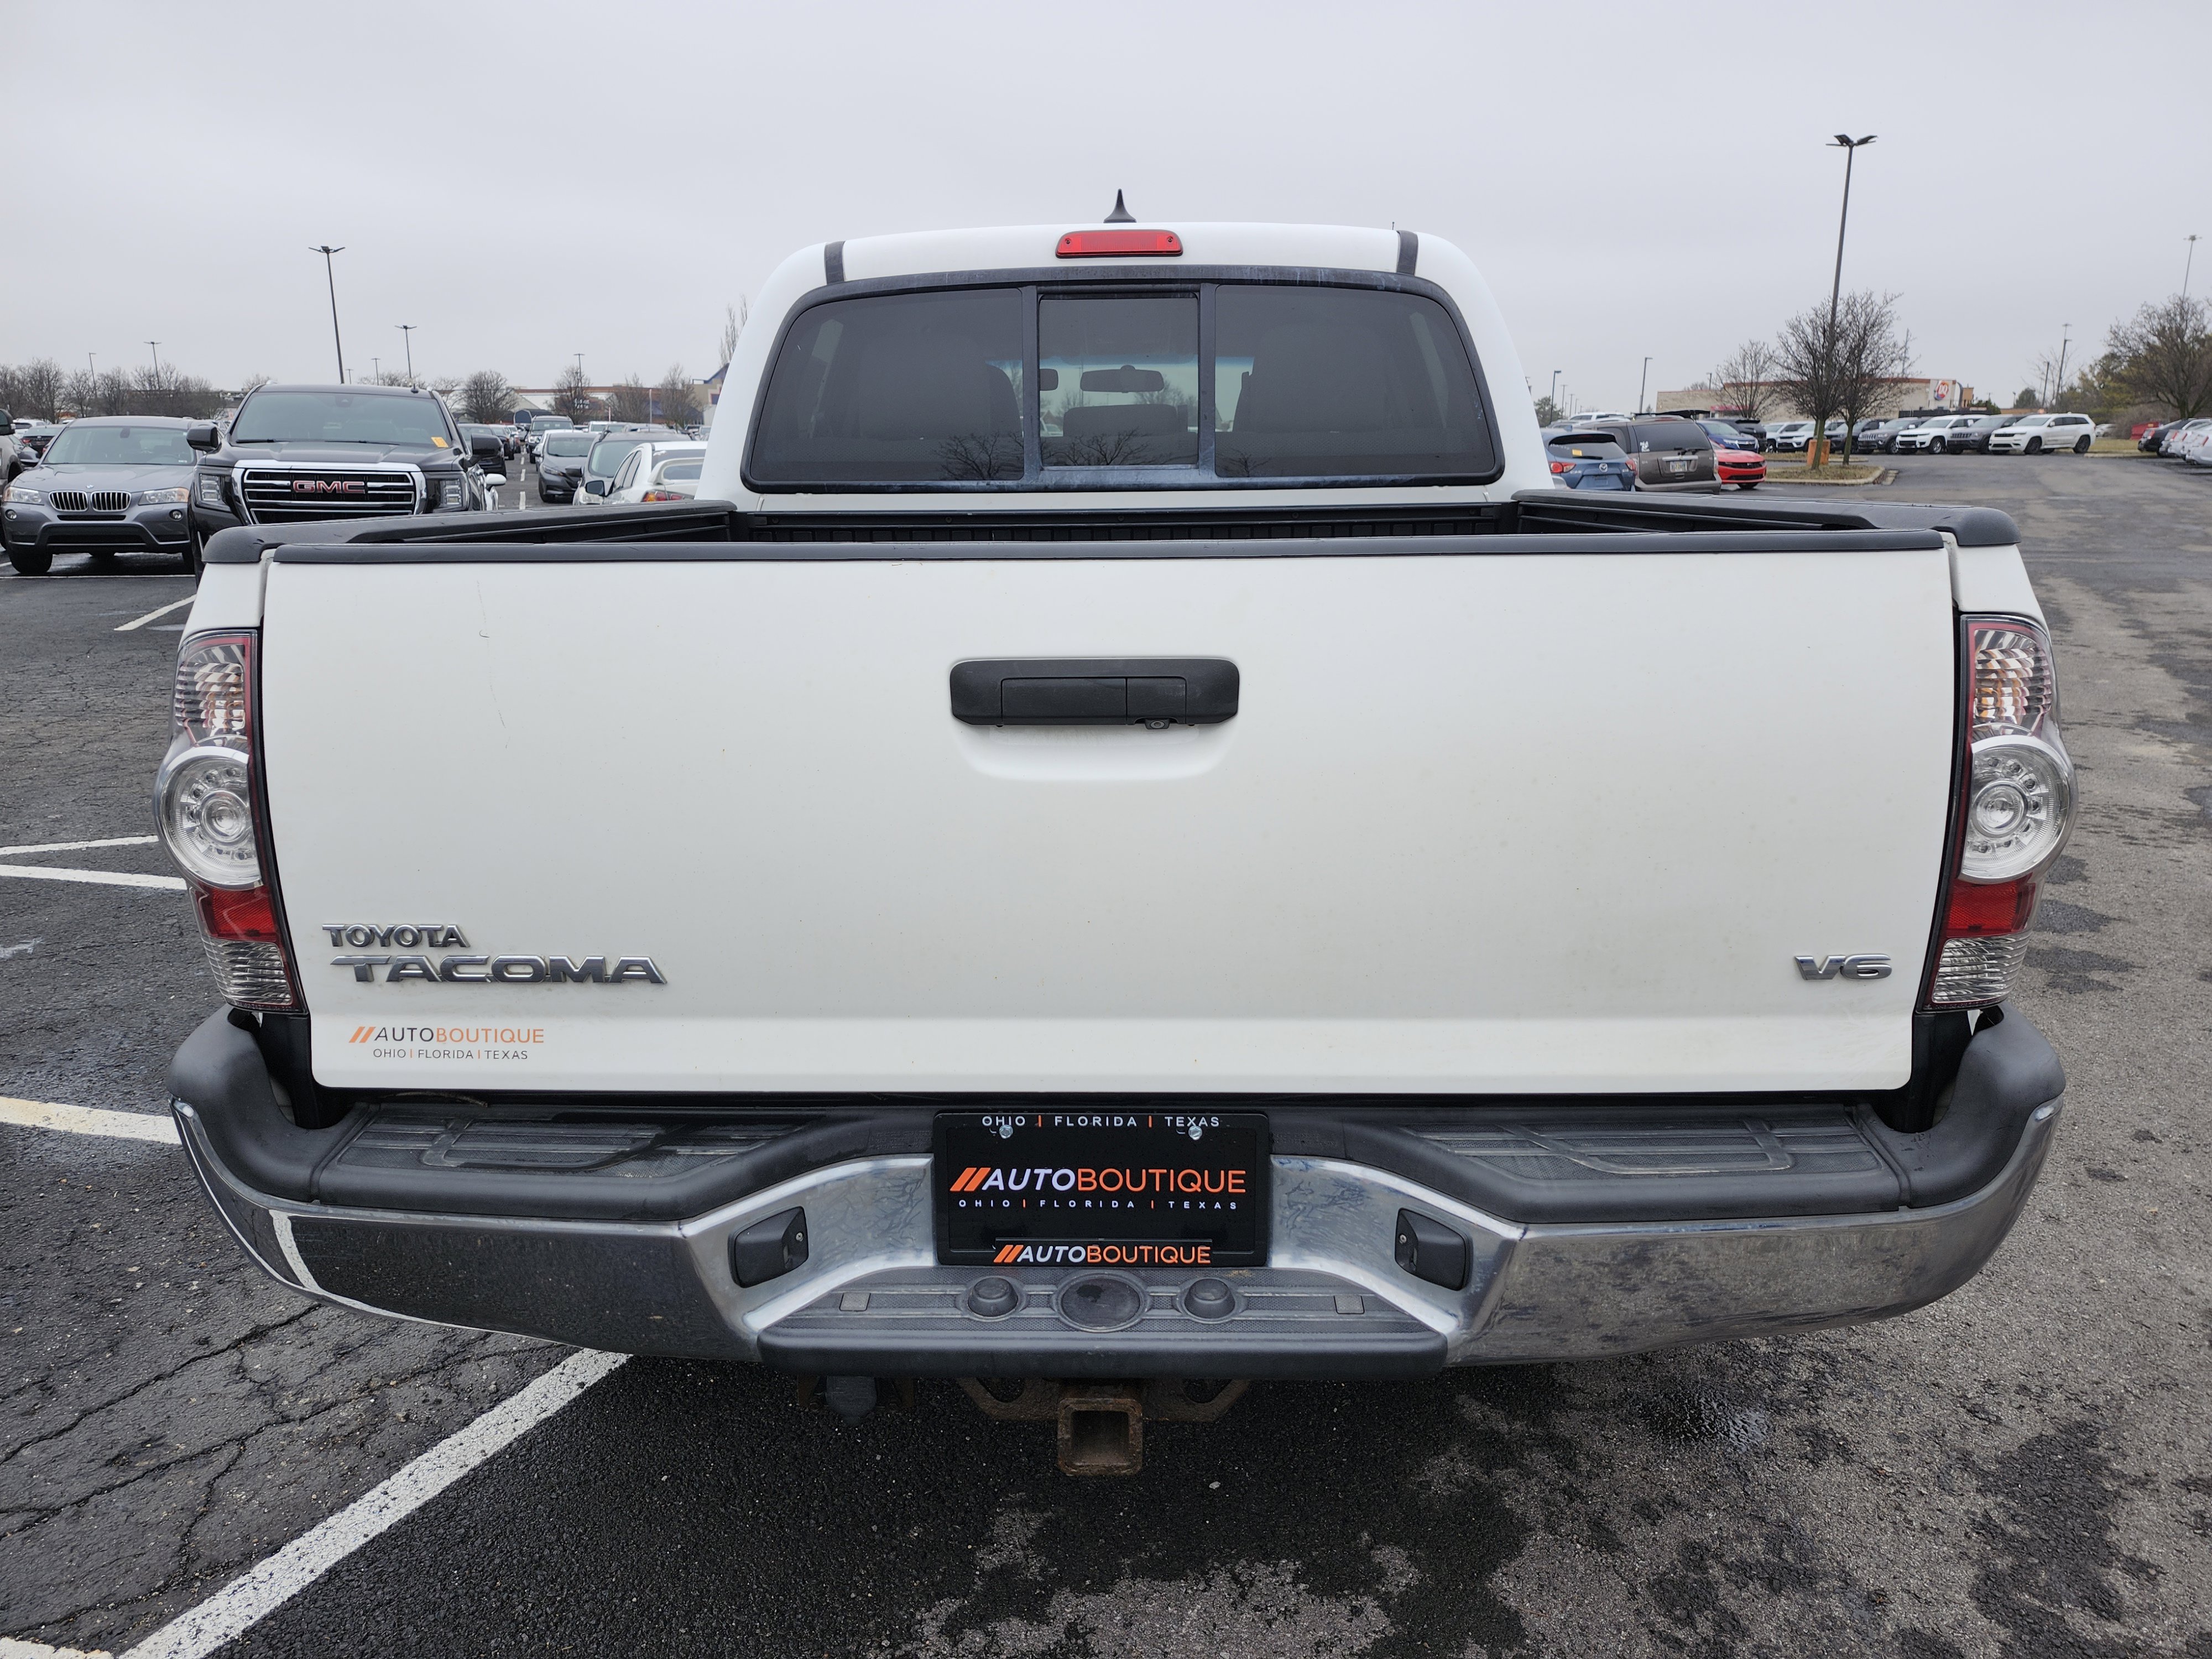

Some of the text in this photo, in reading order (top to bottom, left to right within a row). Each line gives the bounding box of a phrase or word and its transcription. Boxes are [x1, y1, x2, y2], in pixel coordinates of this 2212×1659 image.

[293, 480, 365, 494] GMC
[322, 924, 471, 948] TOYOTA
[330, 954, 667, 984] TACOMA
[1794, 953, 1892, 980] V6
[374, 1027, 544, 1044] AUTOBOUTIQUE
[373, 1048, 528, 1060] OHIO FLORIDA TEXAS
[982, 1115, 1220, 1128] OHIO FLORIDA TEXAS
[982, 1168, 1246, 1193] AUTOBOUTIQUE
[959, 1199, 1237, 1209] OHIO FLORIDA TEXAS
[1018, 1245, 1211, 1264] AUTOBOUTIQUE
